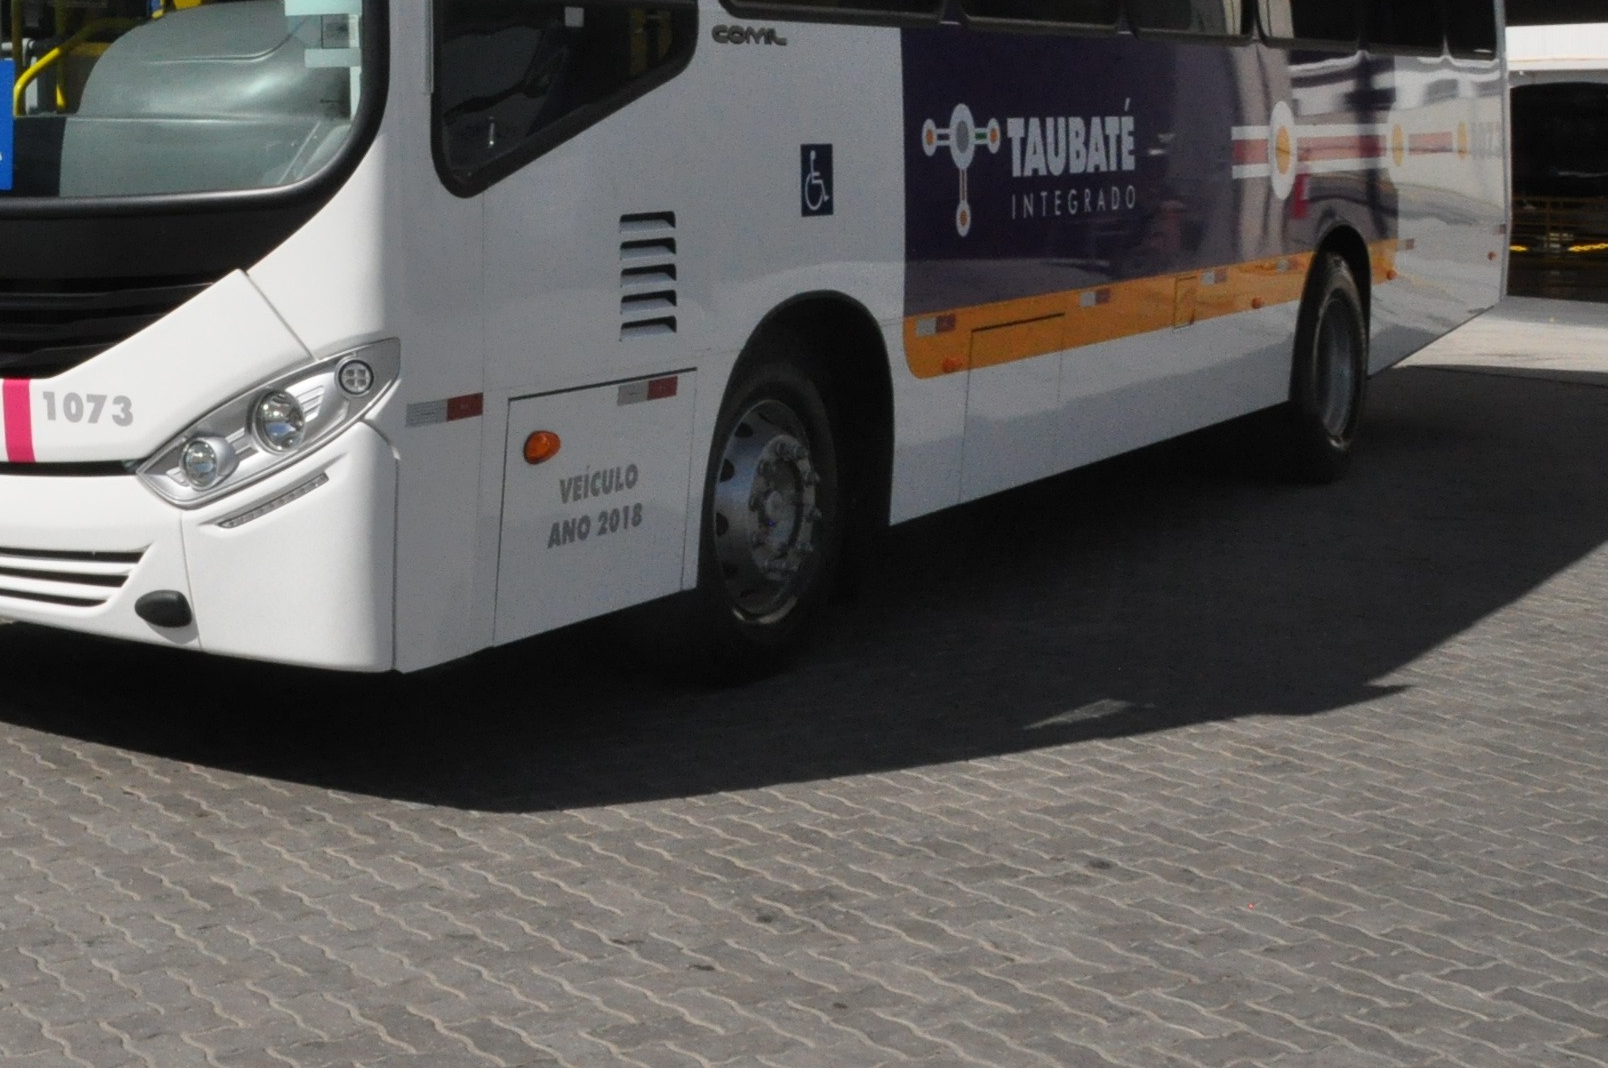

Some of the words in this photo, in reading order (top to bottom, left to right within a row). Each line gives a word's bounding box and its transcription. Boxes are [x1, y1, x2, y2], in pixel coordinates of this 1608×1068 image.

[711, 24, 789, 47] COMIL
[1006, 97, 1136, 178] TAUBATÉ
[1011, 184, 1137, 220] INTEGRADO
[42, 390, 134, 427] 1073
[559, 463, 639, 504] VEÍCULO
[547, 514, 591, 549] ANO
[596, 502, 643, 537] 2018
